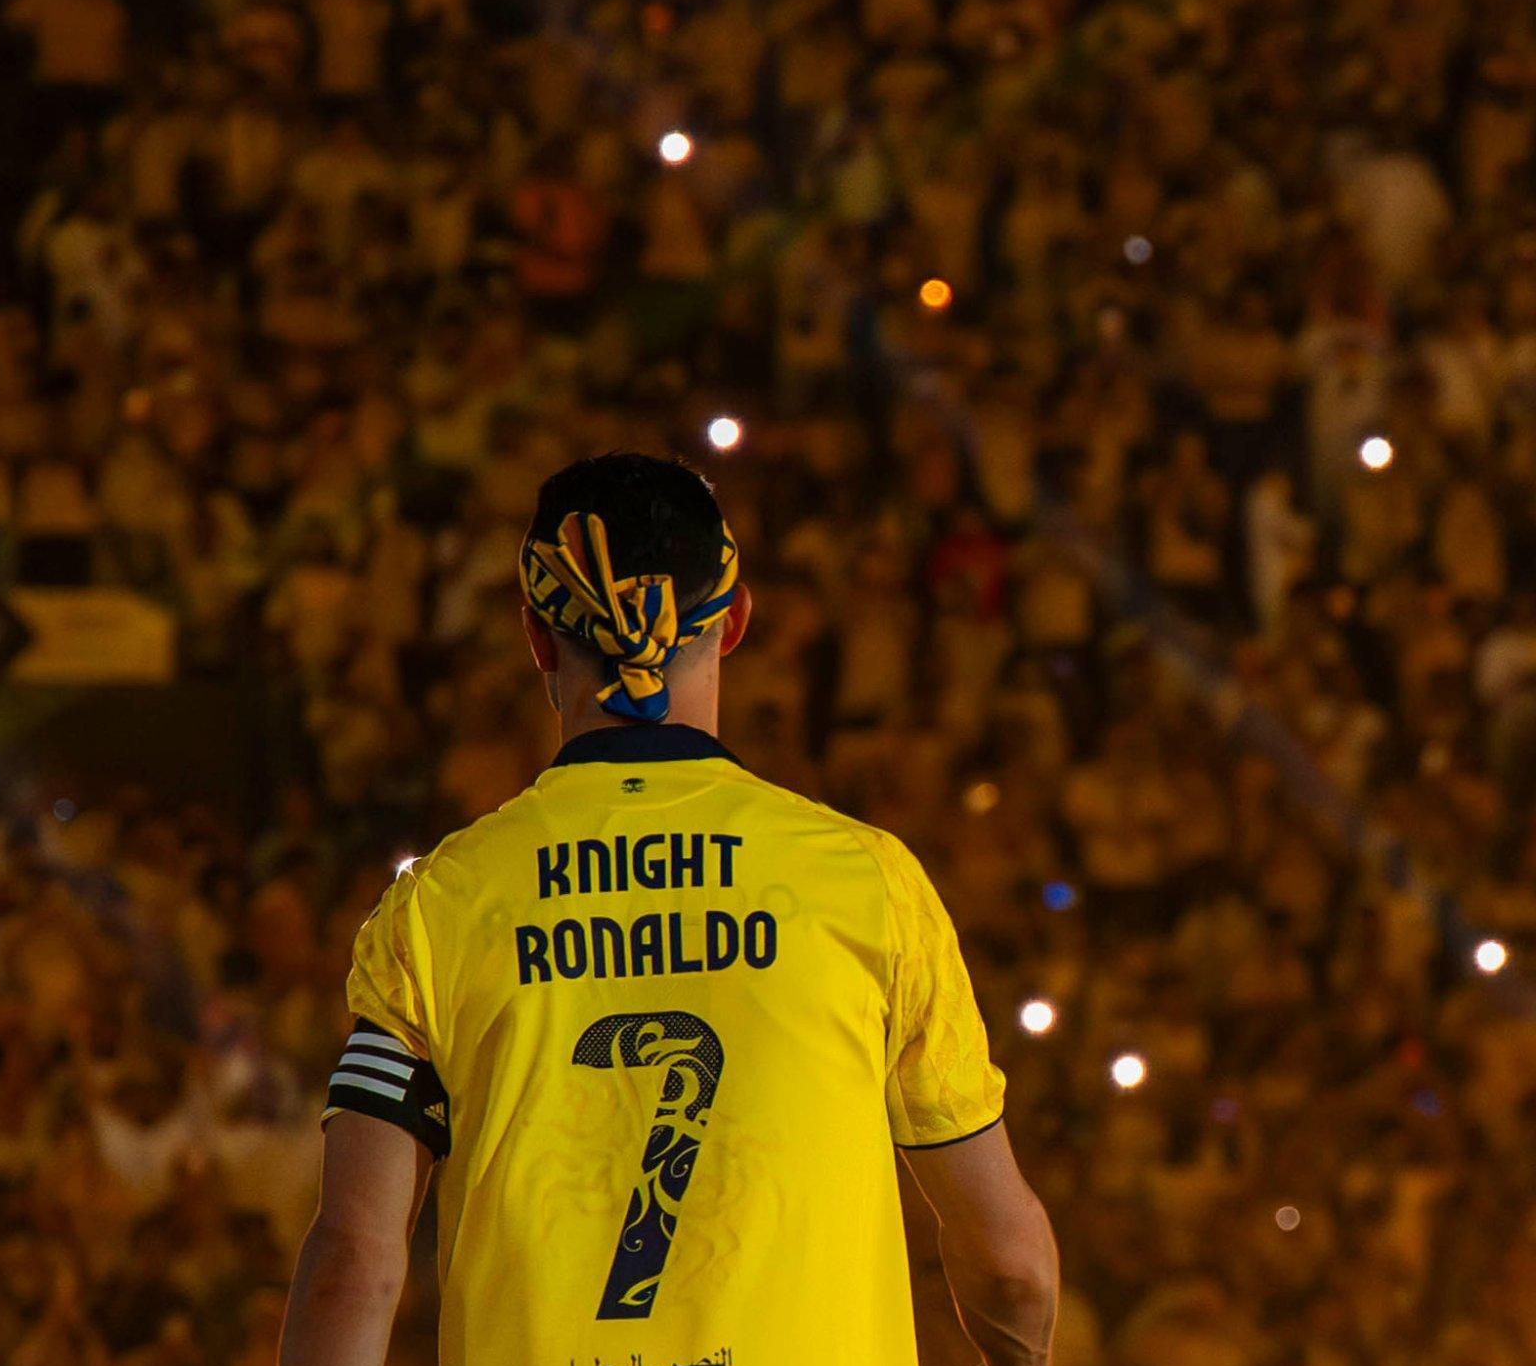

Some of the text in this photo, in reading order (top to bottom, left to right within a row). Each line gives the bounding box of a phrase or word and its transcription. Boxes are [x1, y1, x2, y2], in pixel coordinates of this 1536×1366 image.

[537, 834, 742, 899] KNIGHT
[515, 911, 776, 985] RONALDO
[571, 1010, 725, 1320] 7
